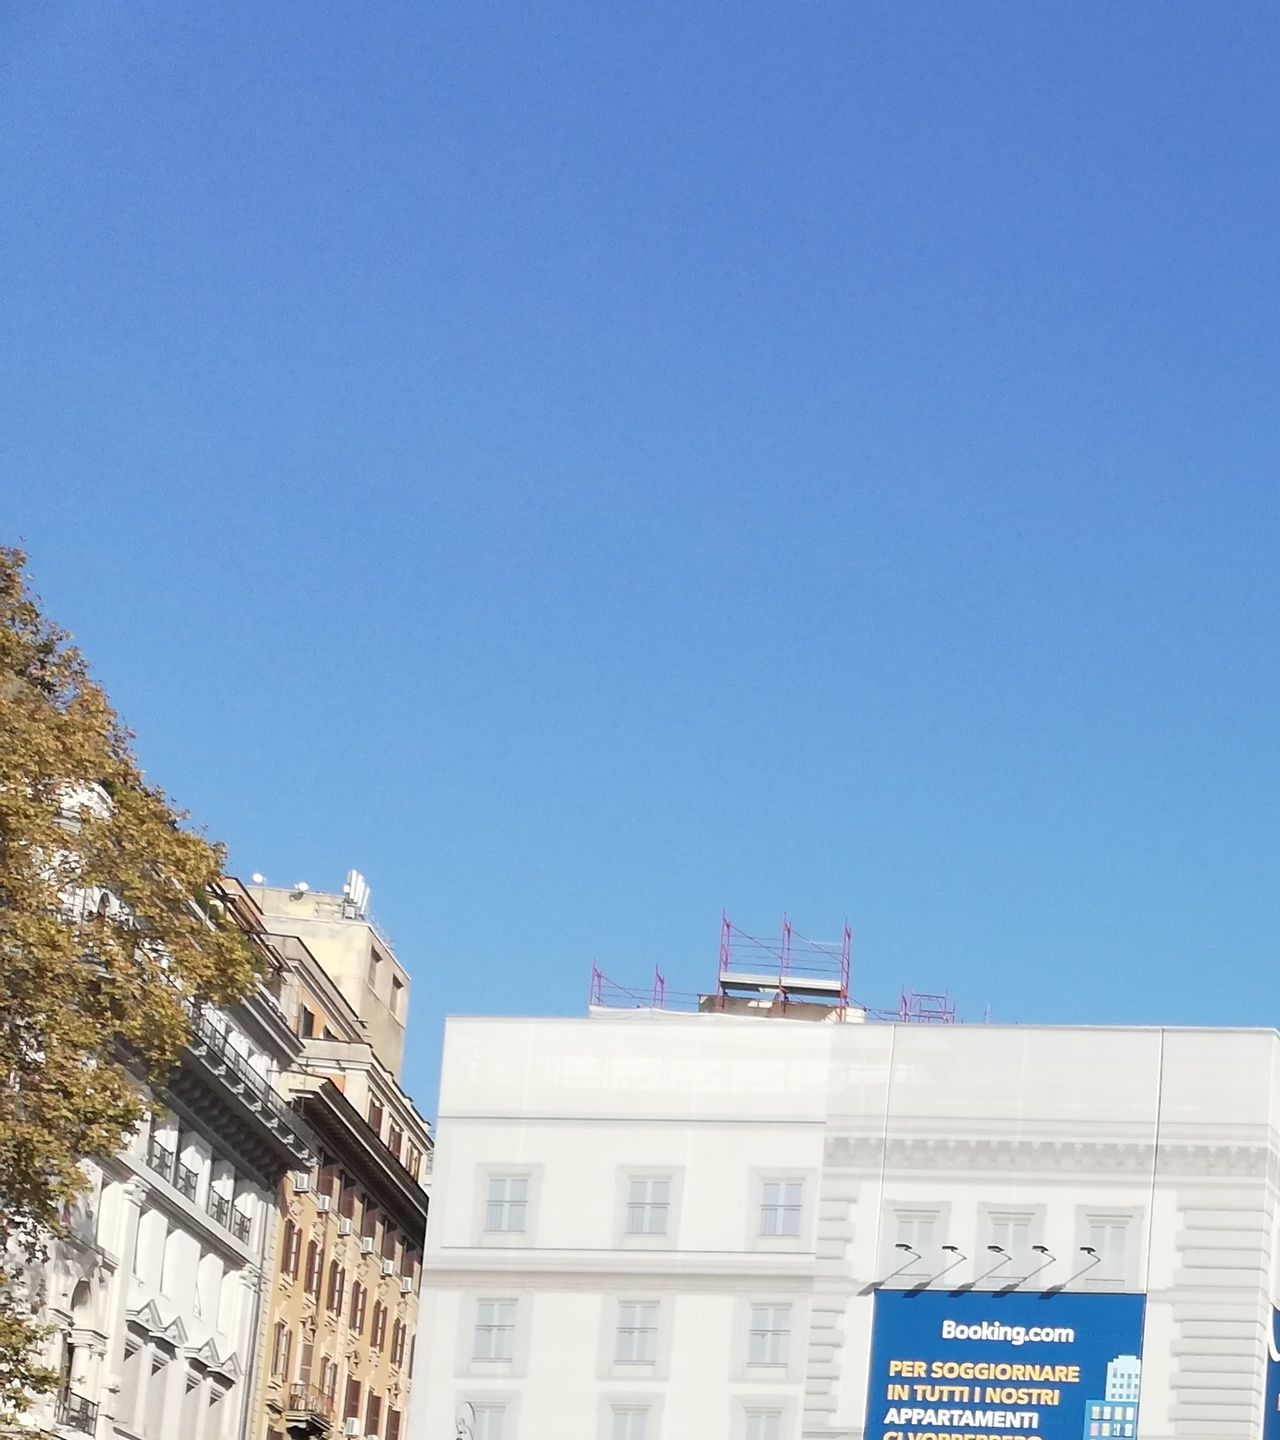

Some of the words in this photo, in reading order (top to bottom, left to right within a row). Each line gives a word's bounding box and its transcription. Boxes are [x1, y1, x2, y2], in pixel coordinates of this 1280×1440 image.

[942, 1320, 1074, 1346] Booking.com
[889, 1360, 927, 1377] PER
[931, 1361, 1080, 1383] SOGGIORNARE
[887, 1384, 909, 1400] IN
[913, 1385, 969, 1402] TUTTI
[974, 1386, 981, 1403] I
[985, 1387, 1060, 1405] NOSTRI
[884, 1408, 1039, 1428] APPARTAMENTI
